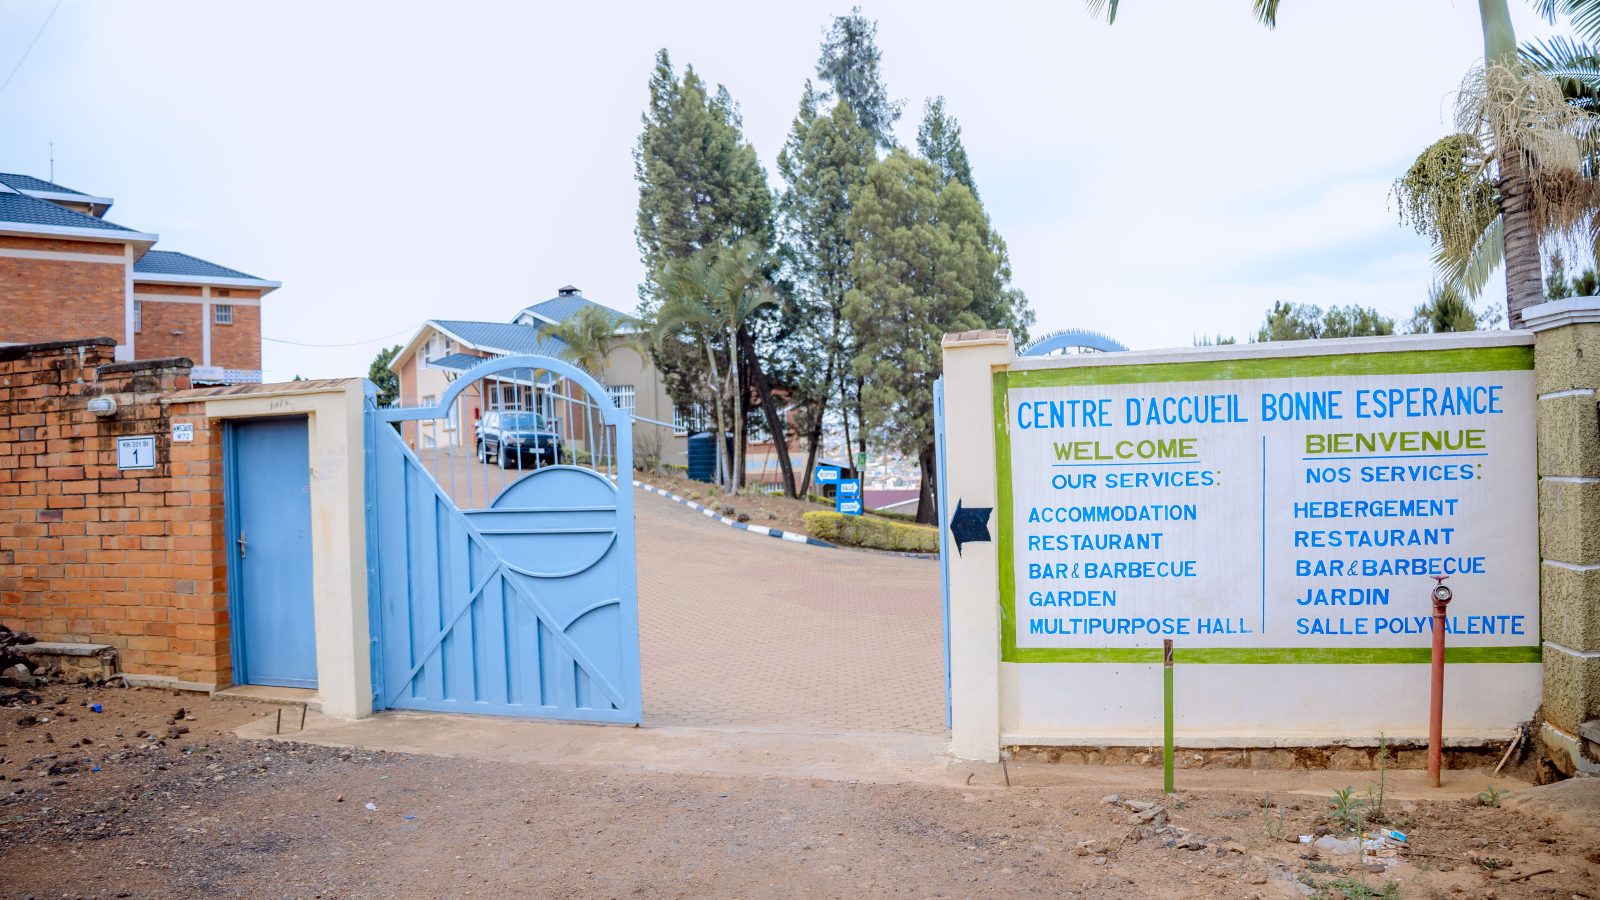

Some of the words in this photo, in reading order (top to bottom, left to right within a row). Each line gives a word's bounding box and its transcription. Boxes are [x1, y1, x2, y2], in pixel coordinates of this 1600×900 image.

[1017, 399, 1113, 429] CENTRE
[1126, 394, 1248, 427] D'ACCUEIL
[1261, 390, 1343, 421] BONNE
[1356, 385, 1503, 418] ESPERANCE
[1053, 438, 1198, 461] WELCOME
[1305, 429, 1486, 454] BIENVENUE
[132, 448, 139, 465] 1
[1052, 472, 1097, 490] OUR
[1105, 470, 1222, 488] SERVICES:
[1306, 466, 1351, 484] NOS
[1361, 463, 1482, 483] SERVICES:
[1028, 504, 1197, 523] ACCOMMODATION
[1294, 498, 1458, 519] HEBERGEMENT
[1028, 532, 1163, 551] RESTAURANT
[1294, 528, 1455, 548] RESTAURANT
[1029, 590, 1117, 607] GARDEN
[1296, 588, 1390, 606] JARDIN
[1029, 617, 1191, 635] MULTIPURPOSE
[1197, 617, 1253, 635] HALL
[1296, 617, 1369, 635] SALLE
